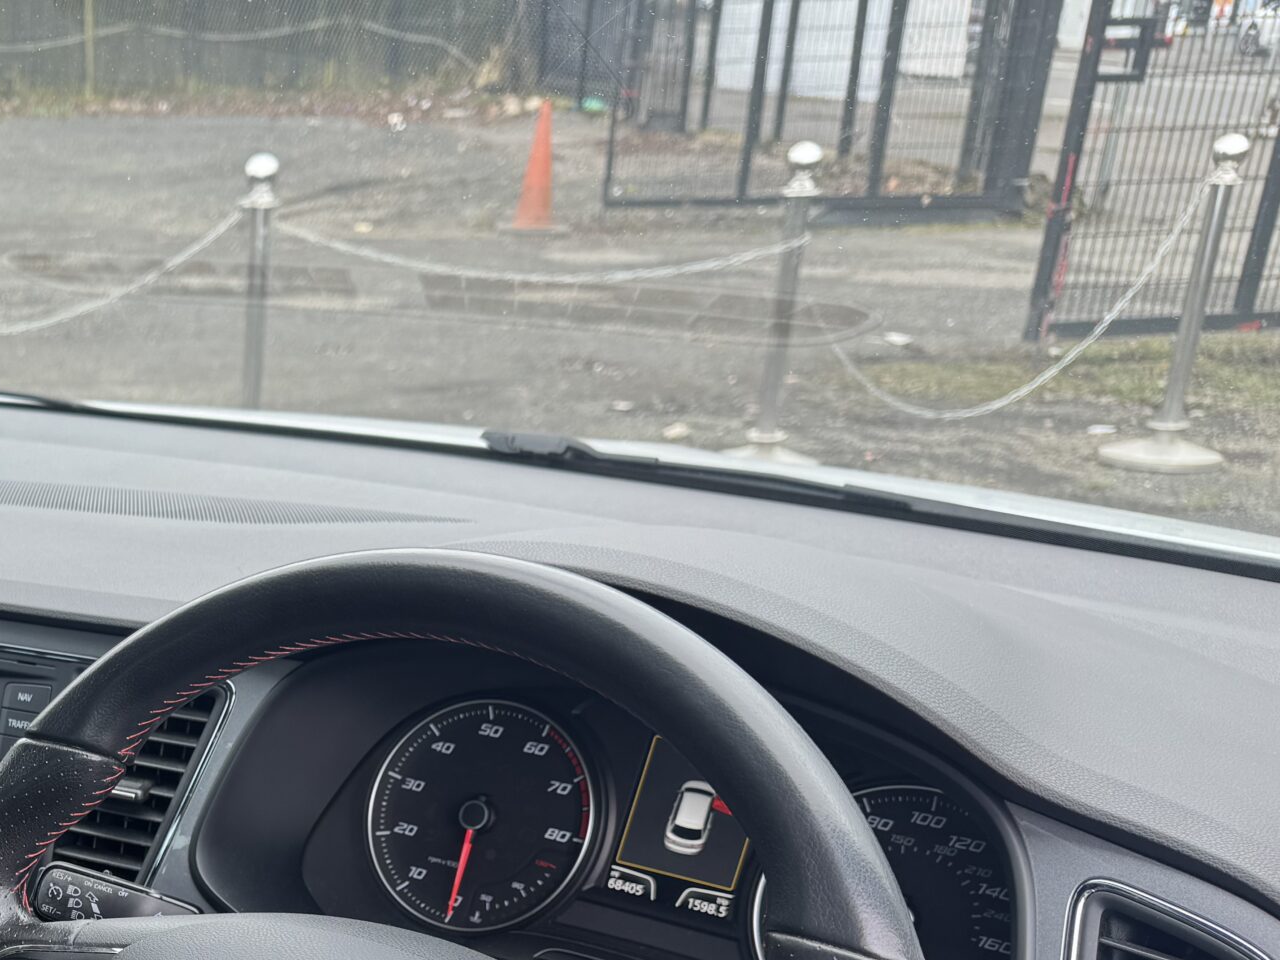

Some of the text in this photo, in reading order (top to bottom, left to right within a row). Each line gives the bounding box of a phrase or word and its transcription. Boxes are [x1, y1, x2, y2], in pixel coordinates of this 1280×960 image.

[17, 692, 33, 703] NAV
[478, 723, 504, 738] 50
[431, 741, 456, 754] 40
[523, 741, 549, 756] 60
[401, 777, 425, 792] 30
[547, 780, 572, 795] 70
[910, 811, 947, 829] 100
[393, 822, 418, 837] 20
[544, 827, 571, 843] 80
[890, 833, 916, 847] 150
[948, 835, 987, 853] 120
[933, 844, 958, 857] 180
[408, 866, 427, 880] 10
[964, 865, 993, 878] 210
[607, 877, 645, 896] 68405
[687, 898, 729, 918] 1598.5
